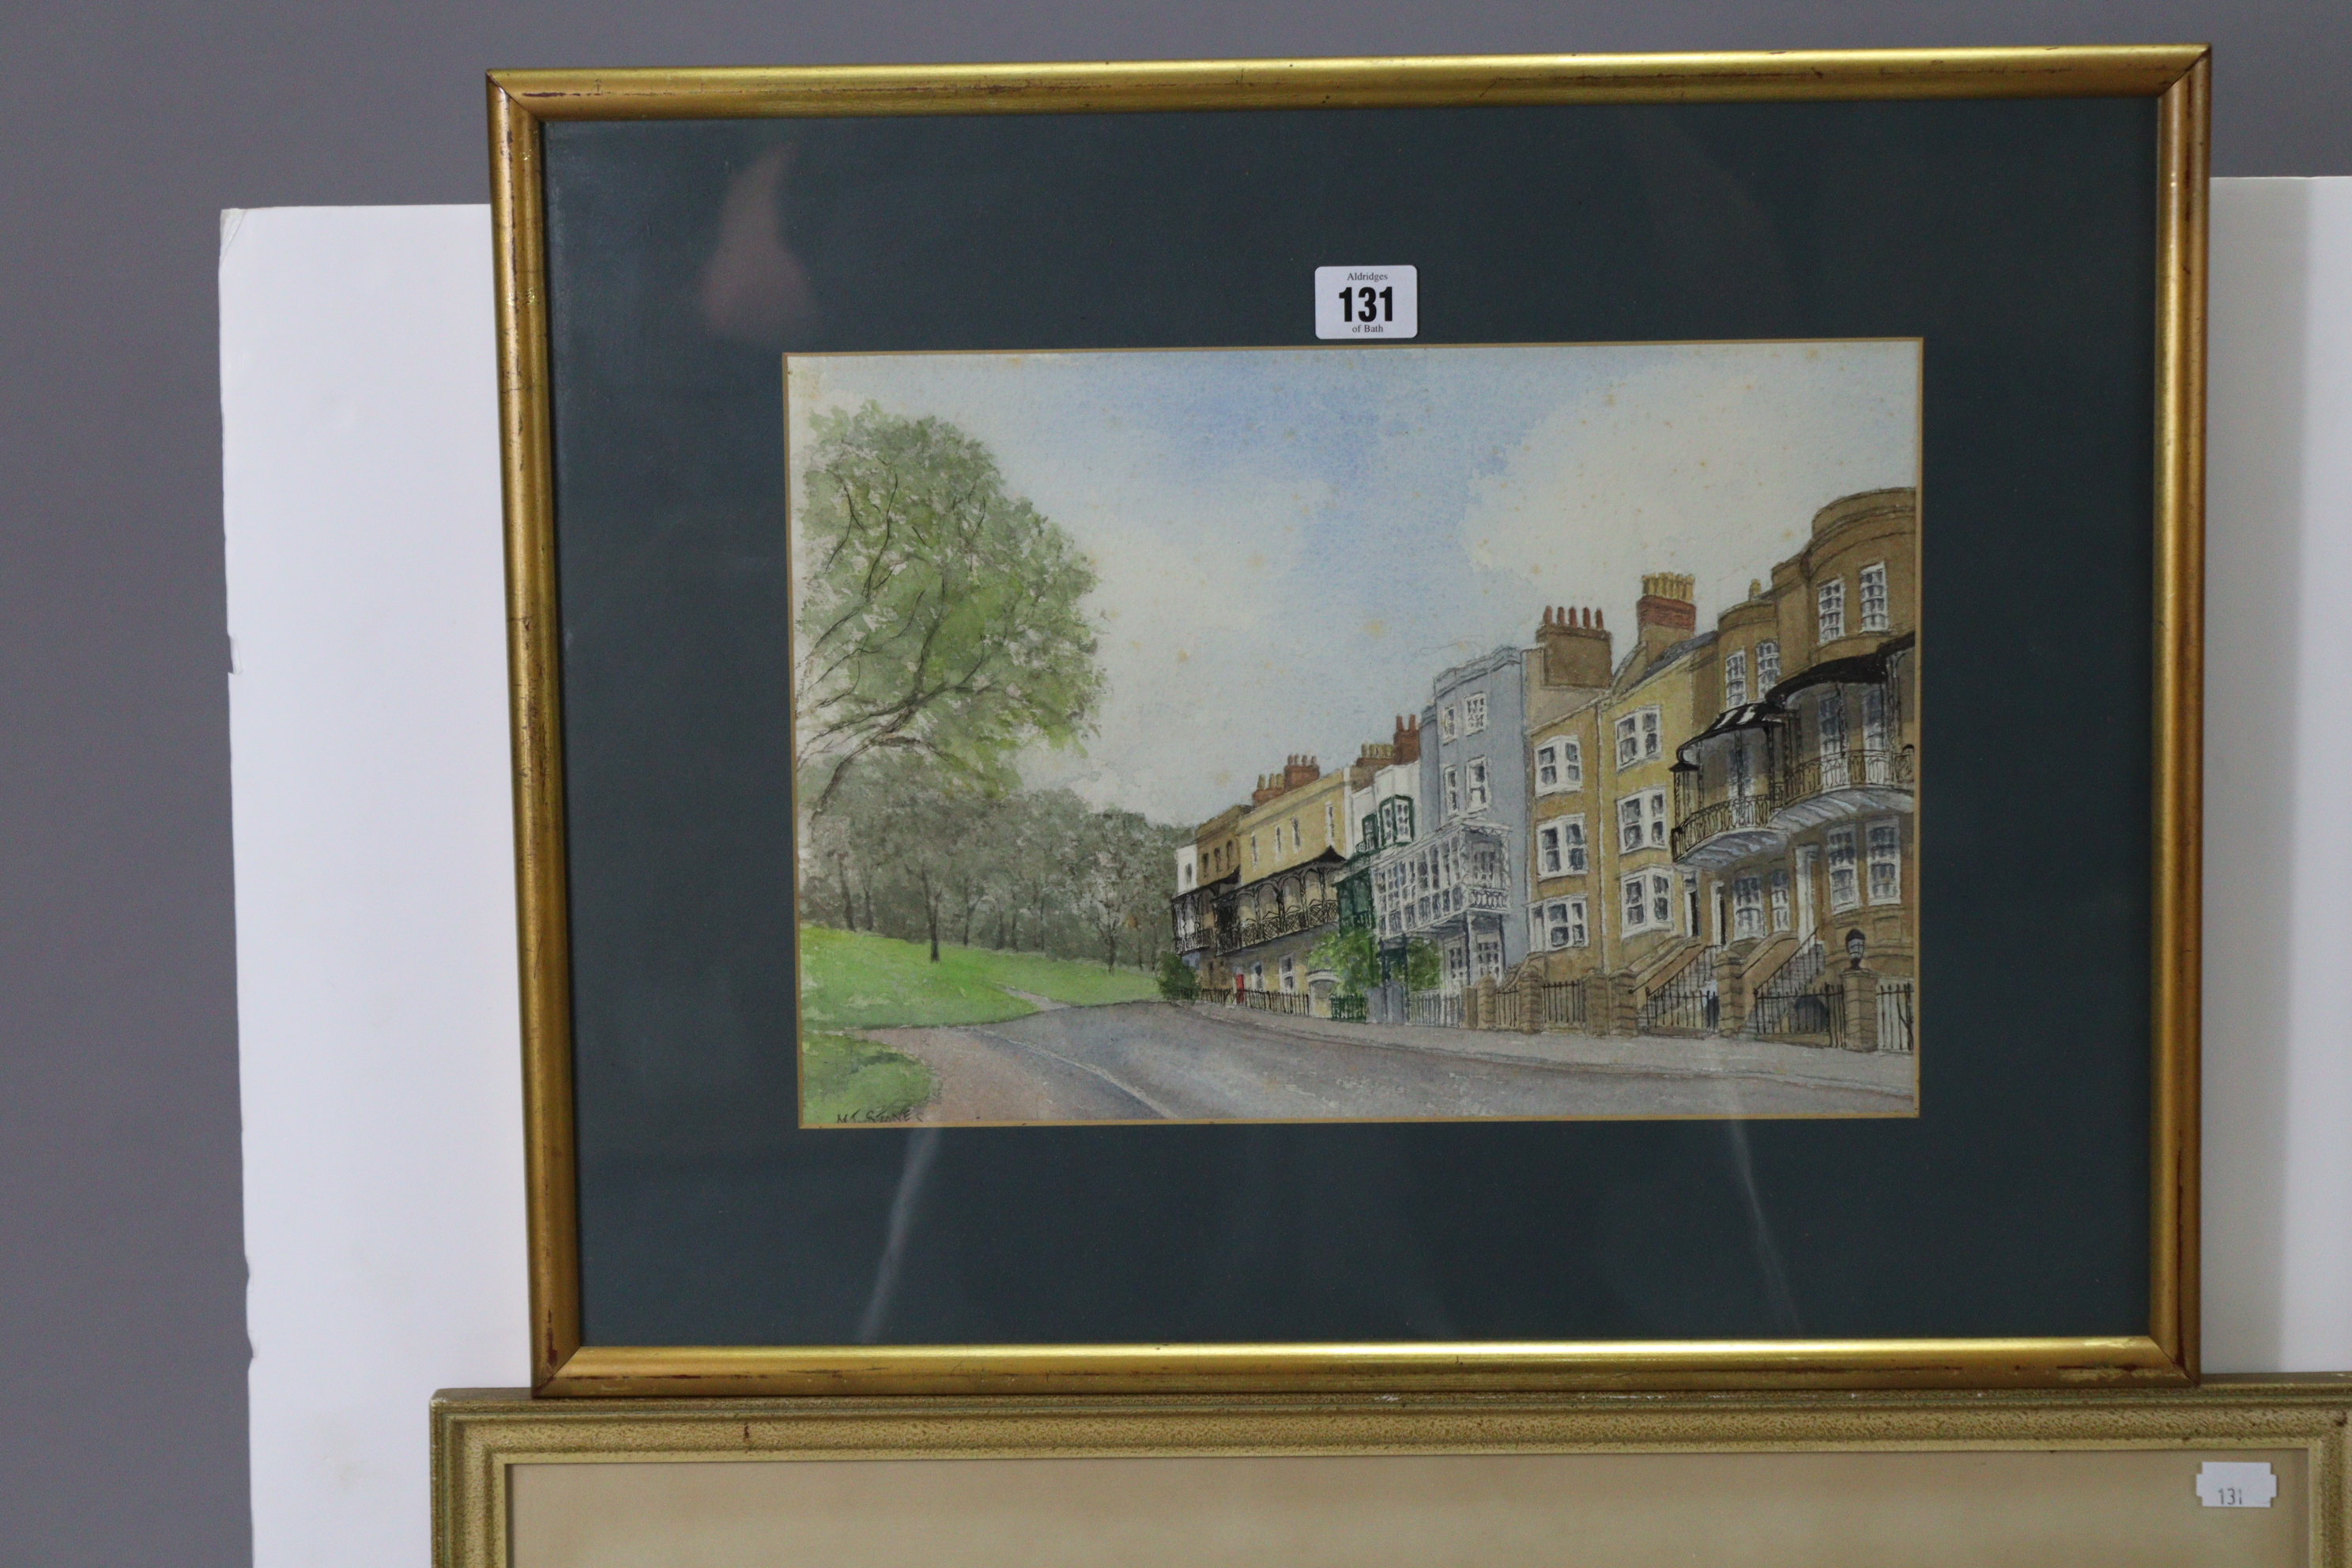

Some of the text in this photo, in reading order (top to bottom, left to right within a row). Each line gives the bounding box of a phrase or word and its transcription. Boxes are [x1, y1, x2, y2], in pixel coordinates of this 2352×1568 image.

[1347, 272, 1389, 282] Aldridges
[1338, 286, 1393, 322] 131
[1351, 324, 1384, 333] of Bath
[2218, 1487, 2243, 1505] 131
